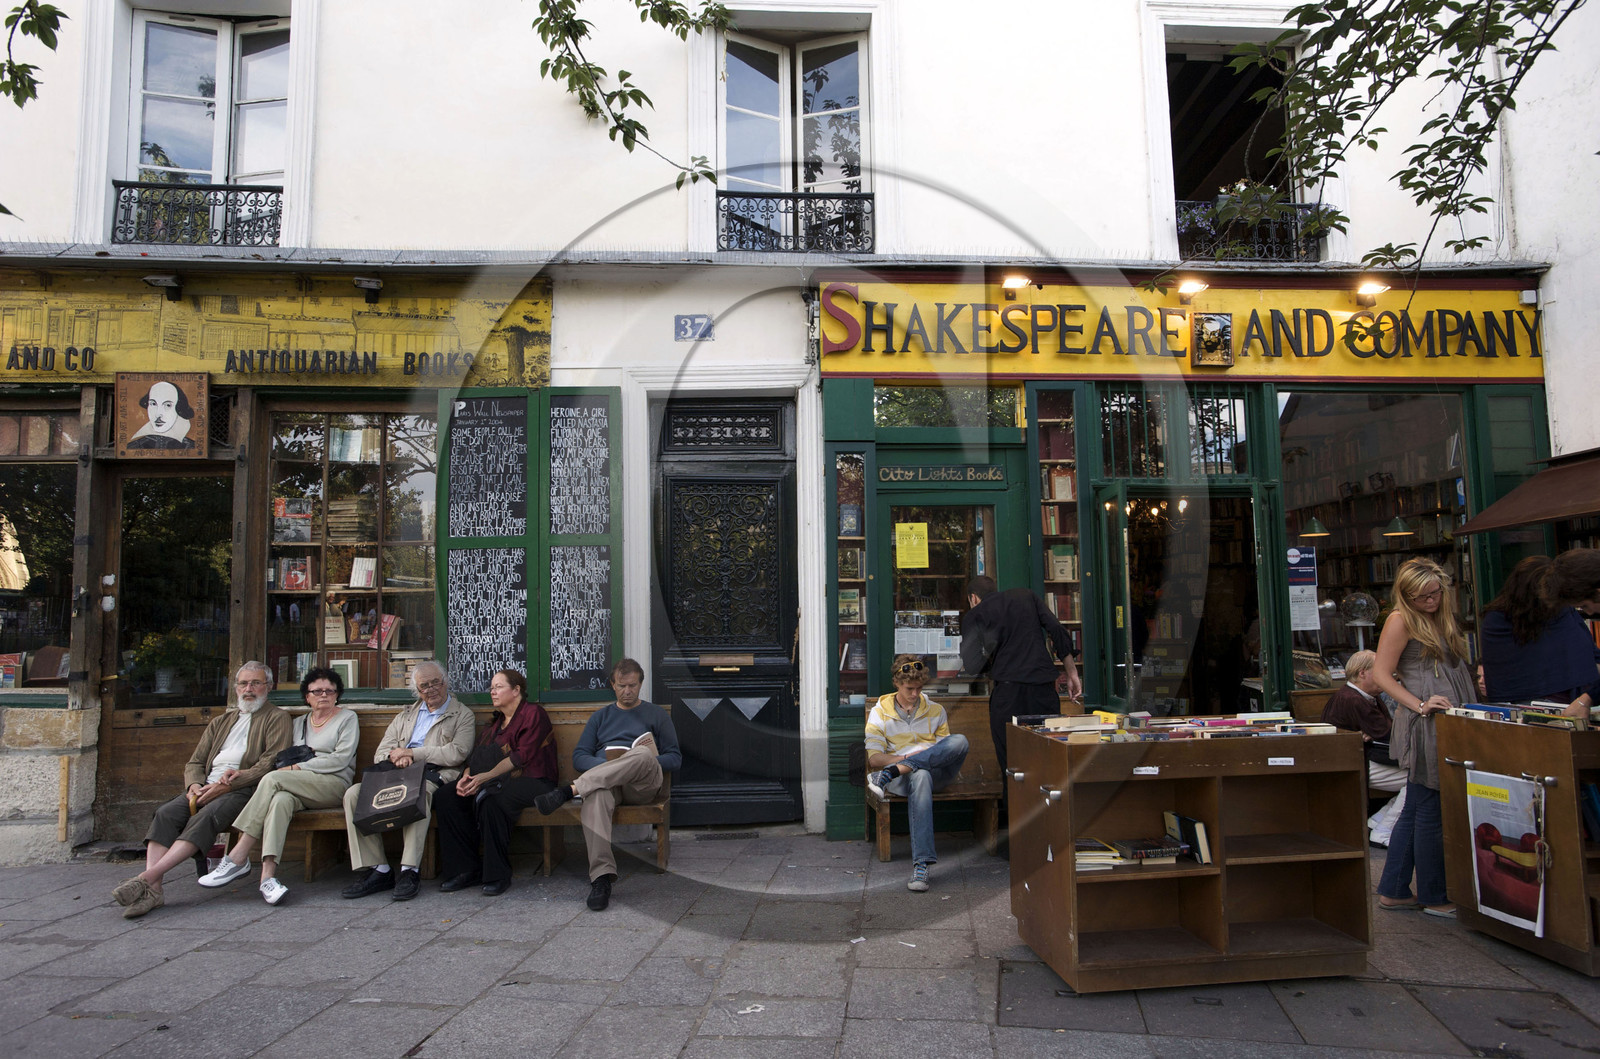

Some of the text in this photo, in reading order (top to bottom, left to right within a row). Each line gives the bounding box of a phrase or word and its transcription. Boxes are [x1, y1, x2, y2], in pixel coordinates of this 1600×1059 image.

[821, 282, 1542, 359] SHAKESPEARE AND COMPANY
[680, 318, 707, 338] 37
[6, 347, 95, 371] AND CO
[225, 350, 475, 376] ANTIQUARIAN BOOKS
[591, 408, 607, 418] GIRL
[551, 418, 608, 429] CALLED NASTASIA
[452, 427, 524, 437] SOME PEOPLE CALL ME
[587, 428, 602, 438] ONE
[452, 436, 518, 446] THE DON QUIXOTE
[551, 438, 606, 448] HUNDRED YEARS
[452, 444, 527, 455] OF THE LATIN QUARTER
[551, 448, 565, 458] AGO
[567, 447, 576, 458] MY
[451, 454, 518, 465] BECAUSE MY HEAD
[551, 458, 605, 468] WAS WINE SHOP
[458, 464, 523, 475] SO FAR UP IN THE
[573, 468, 588, 477] FROM
[590, 468, 602, 477] THE
[880, 468, 915, 481] City
[919, 468, 963, 480] Lights
[450, 474, 522, 485] CLOUDS THAT CAN
[551, 477, 568, 486] SEINE
[504, 483, 512, 492] US
[514, 483, 526, 492] ARE
[560, 487, 606, 495] THE HOTEL DIEU
[487, 492, 524, 502] PARADISE.
[597, 496, 609, 504] HAS
[450, 501, 509, 512] AND INSTEAD OF
[568, 505, 581, 514] BEEN
[450, 510, 513, 520] BEING BONAFIDE
[572, 514, 601, 524] REPLACED
[450, 520, 492, 529] BOOKSELLER
[588, 524, 604, 534] AND
[450, 527, 526, 537] LIKE FRUSTRATED
[450, 548, 525, 557] NOVELIST STORE HAS
[488, 556, 523, 564] CHAPTERS
[449, 564, 516, 574] IN NOVEL AND THE
[448, 575, 464, 584] FACT
[507, 574, 521, 583] AND
[500, 582, 513, 591] ARE
[449, 589, 527, 600] MORE REAL TO THAN
[449, 600, 496, 609] MY NEXT DOOR
[463, 608, 496, 617] AND EVEN
[455, 616, 526, 625] THE FACT THAT EVEN
[448, 626, 517, 636] BEFORE WAS BORN
[494, 635, 514, 643] WROTE
[448, 643, 516, 653] THE STORY MY LIFE
[455, 652, 497, 662] BOOK CALLED
[551, 653, 573, 661] YEARS
[470, 661, 526, 671] AND EVER SINCE
